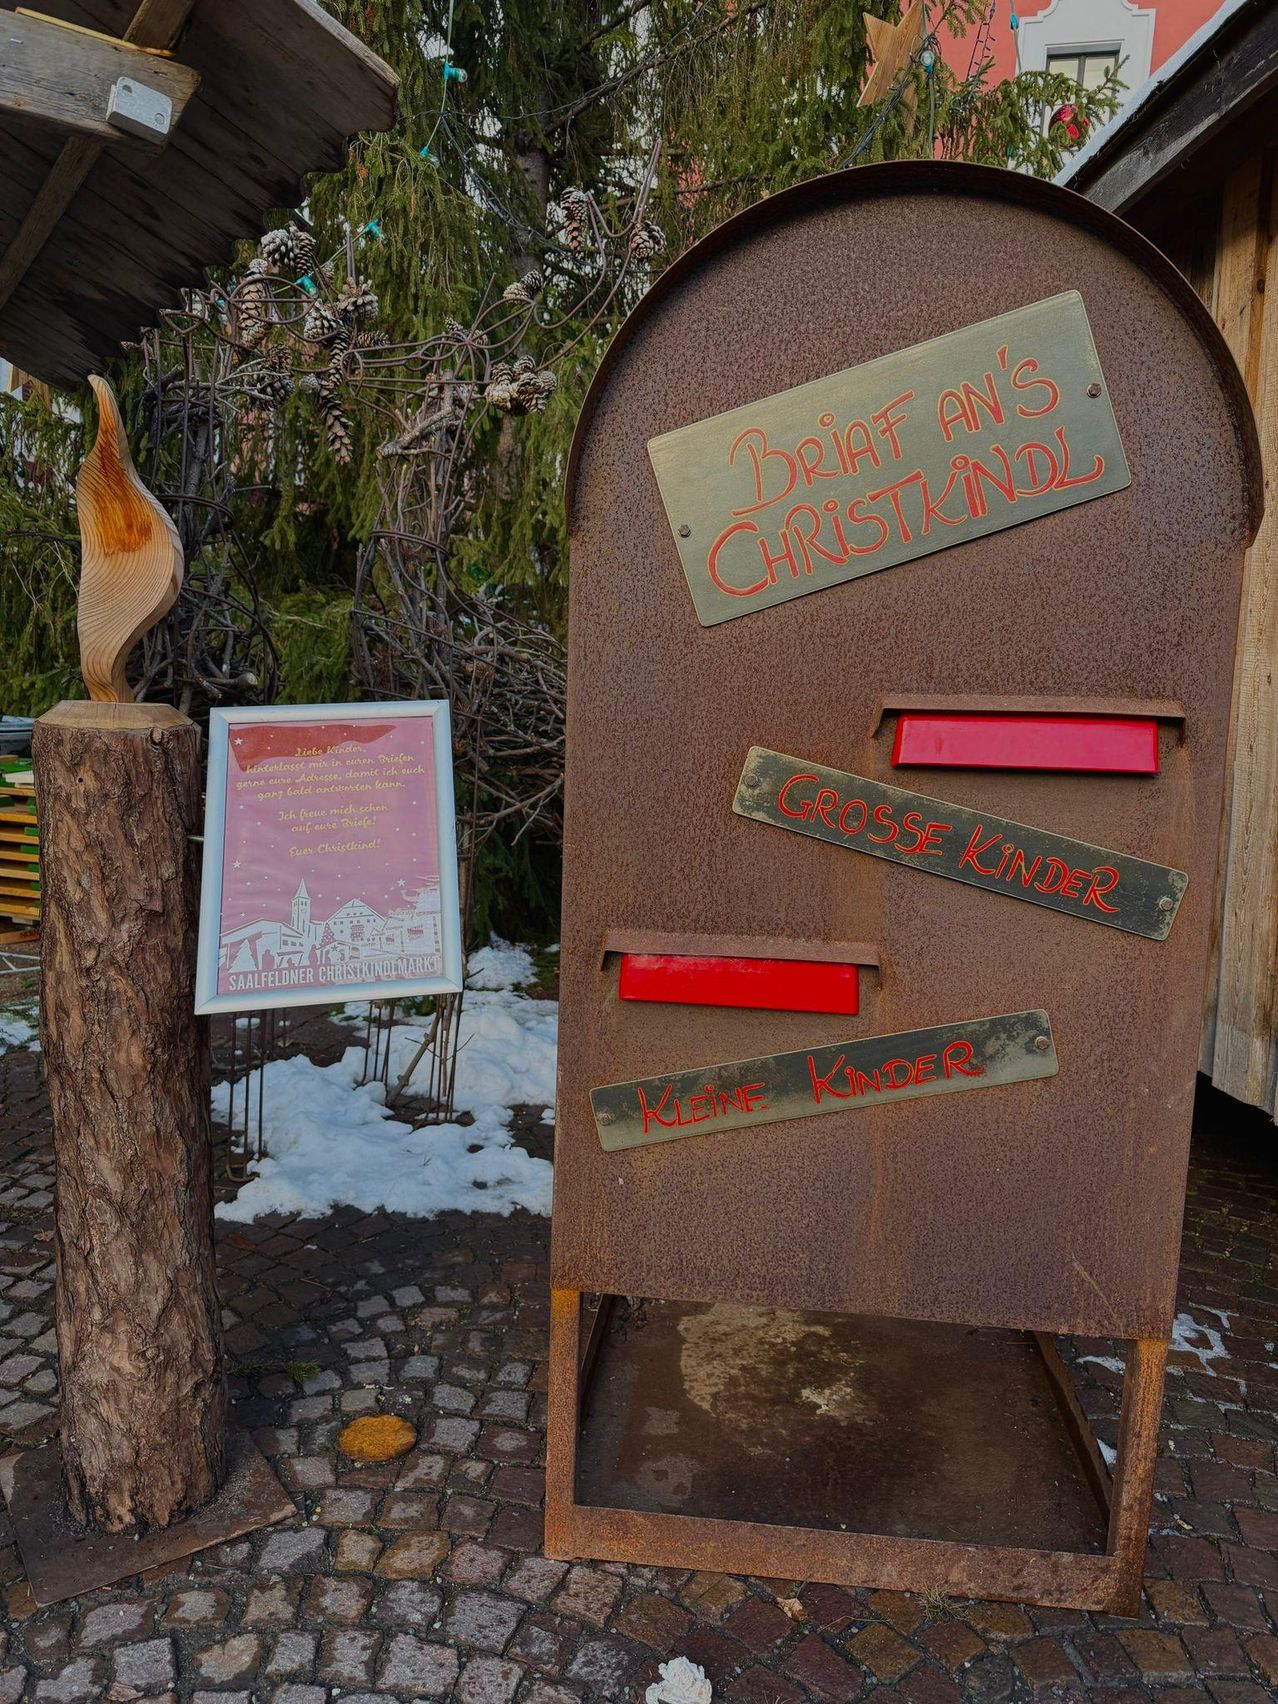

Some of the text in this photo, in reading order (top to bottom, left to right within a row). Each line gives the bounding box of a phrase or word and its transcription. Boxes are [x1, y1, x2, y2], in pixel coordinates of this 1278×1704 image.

[938, 344, 1061, 443] AN'S
[295, 747, 322, 757] Liebe
[246, 753, 415, 774] hinterlasst mir in euren Briefen
[236, 779, 265, 790] gerne
[269, 777, 291, 785] eure
[345, 768, 379, 778] damit
[382, 767, 398, 776] ich
[401, 765, 425, 774] euch
[257, 780, 406, 801] ganz bald antworten kann.
[278, 810, 296, 821] Ich
[299, 808, 327, 821] freue
[330, 804, 355, 815] mich
[777, 773, 952, 856] GROSSE
[291, 816, 377, 833] auf eure Briefe!
[288, 838, 381, 857] Euer Christkind!
[229, 967, 315, 991] SAALFELDNER
